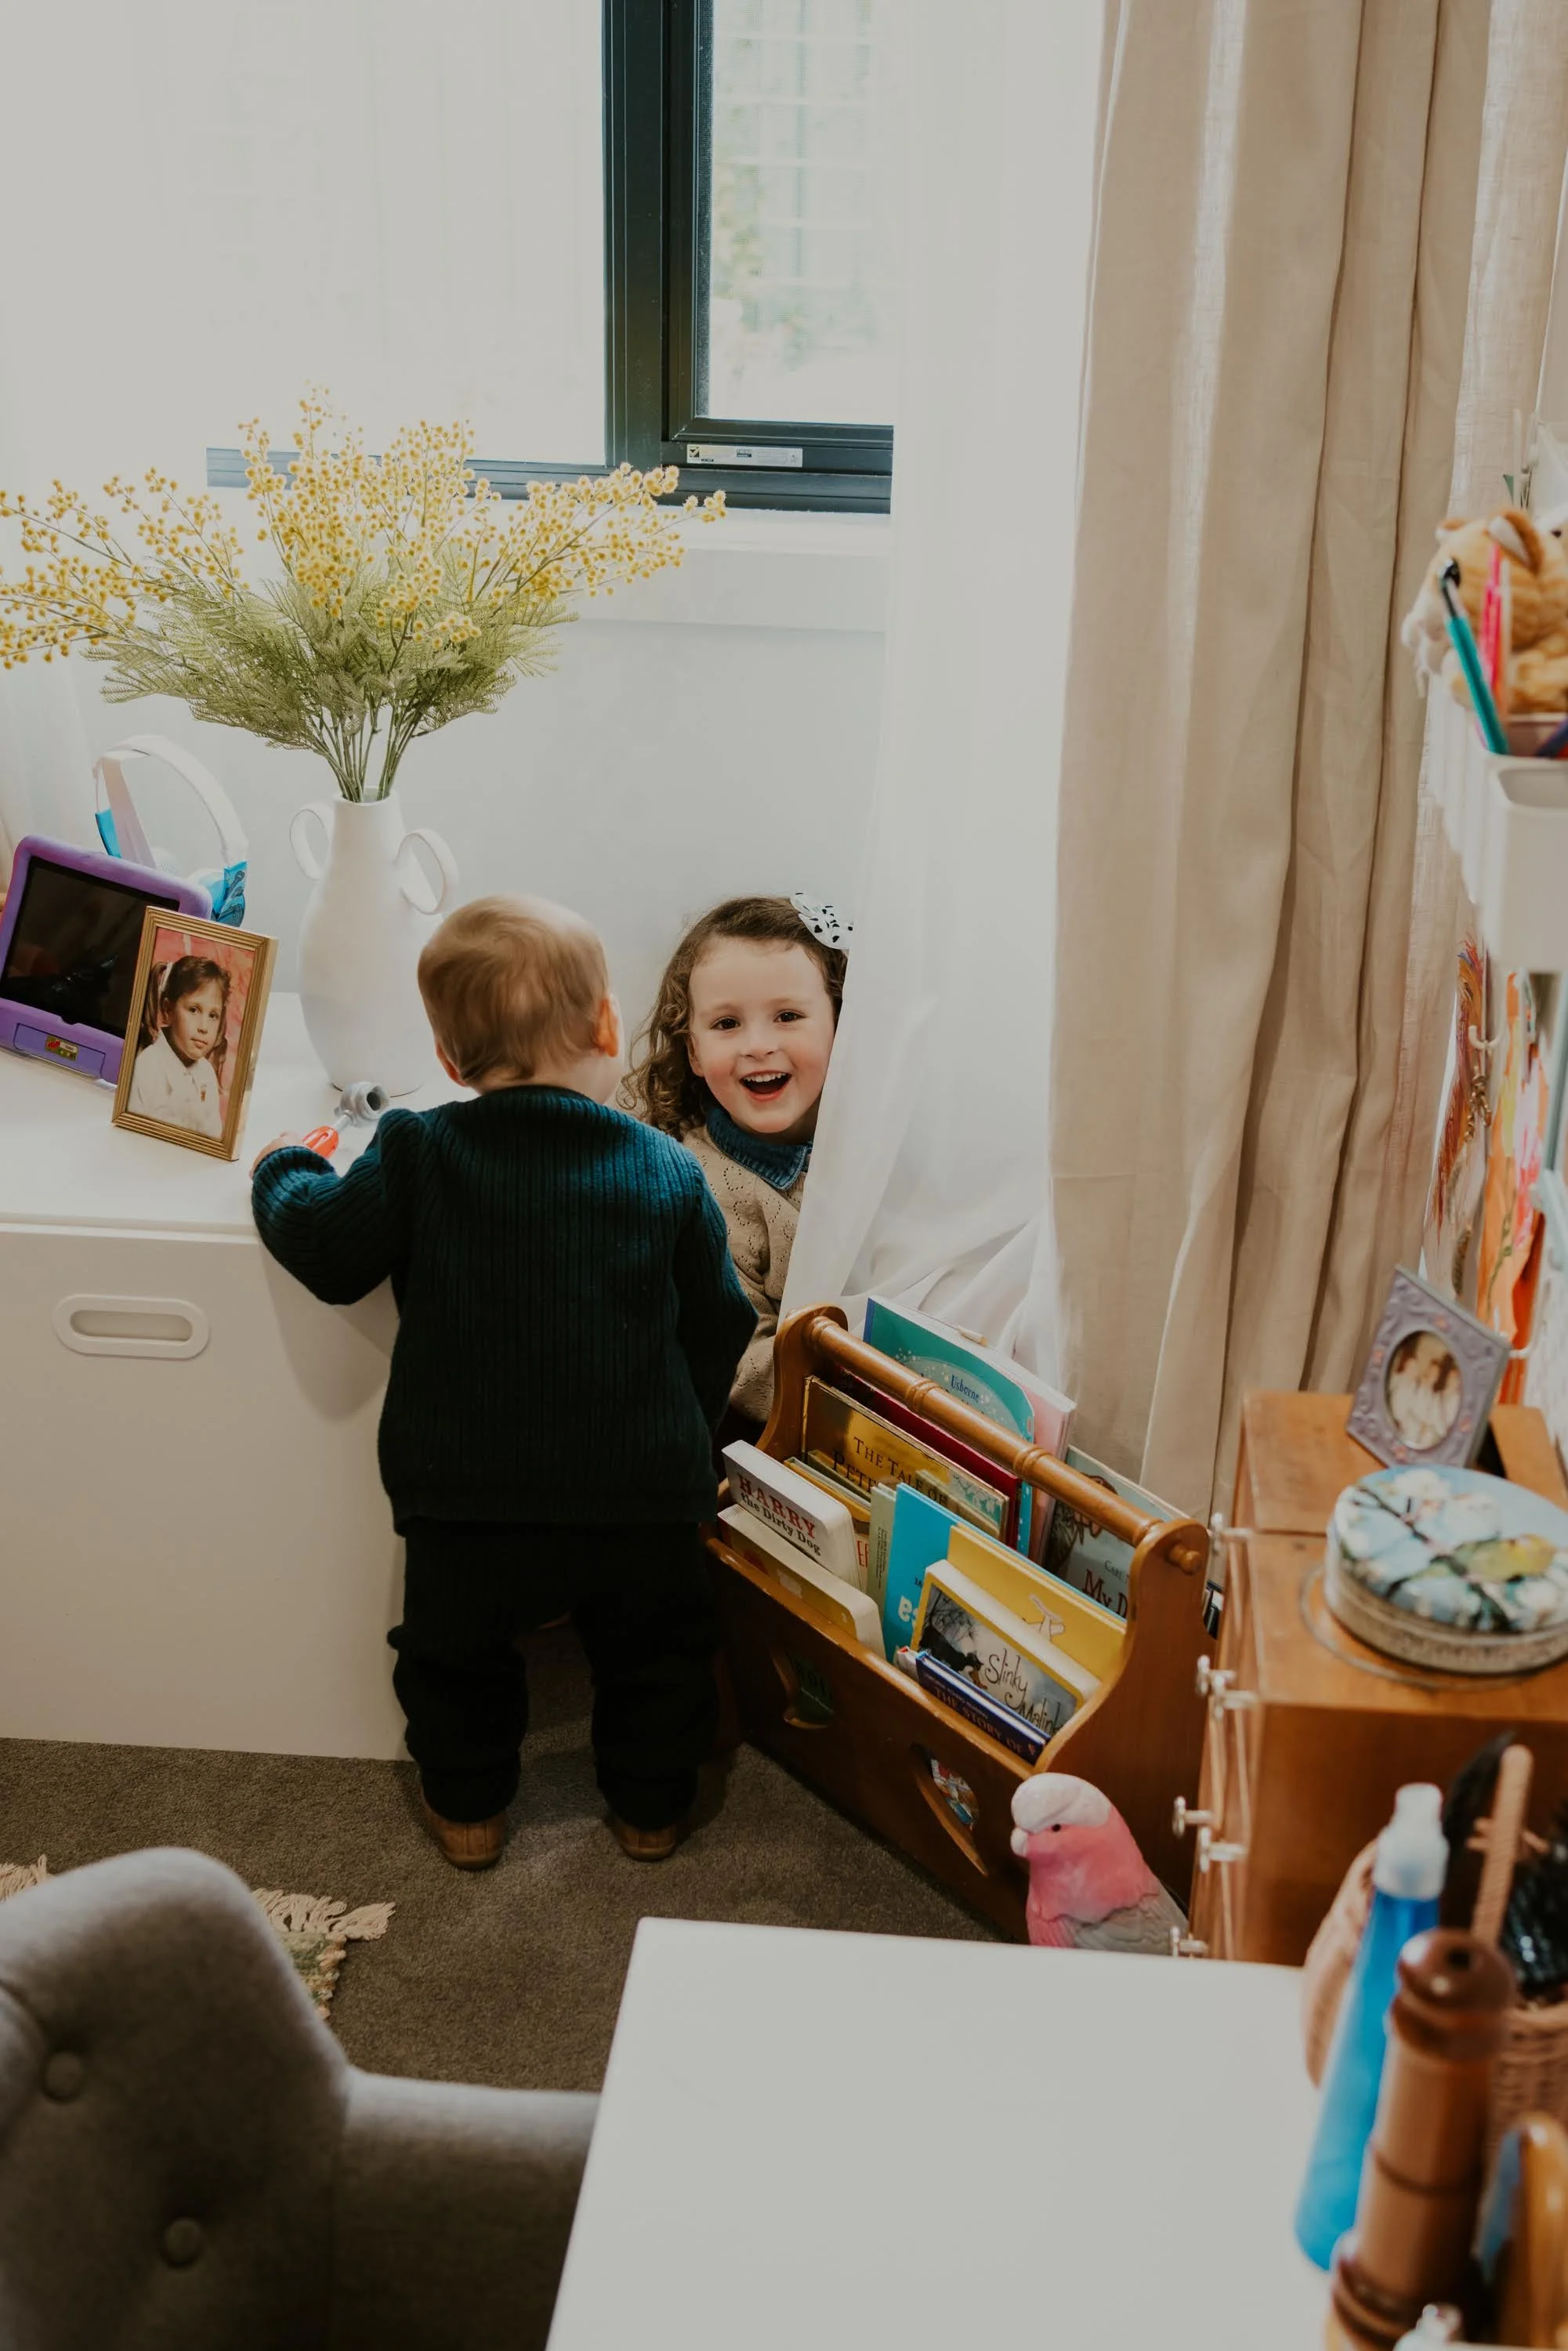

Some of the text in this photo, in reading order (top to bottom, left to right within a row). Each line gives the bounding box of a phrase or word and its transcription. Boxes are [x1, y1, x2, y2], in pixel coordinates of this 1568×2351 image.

[951, 1374, 980, 1403] Usborne
[833, 1450, 877, 1493] PETE
[853, 1436, 883, 1469] THE
[737, 1473, 816, 1539] HARRY
[741, 1493, 821, 1556] the Dirty Dog
[985, 1648, 1028, 1709] Slinky
